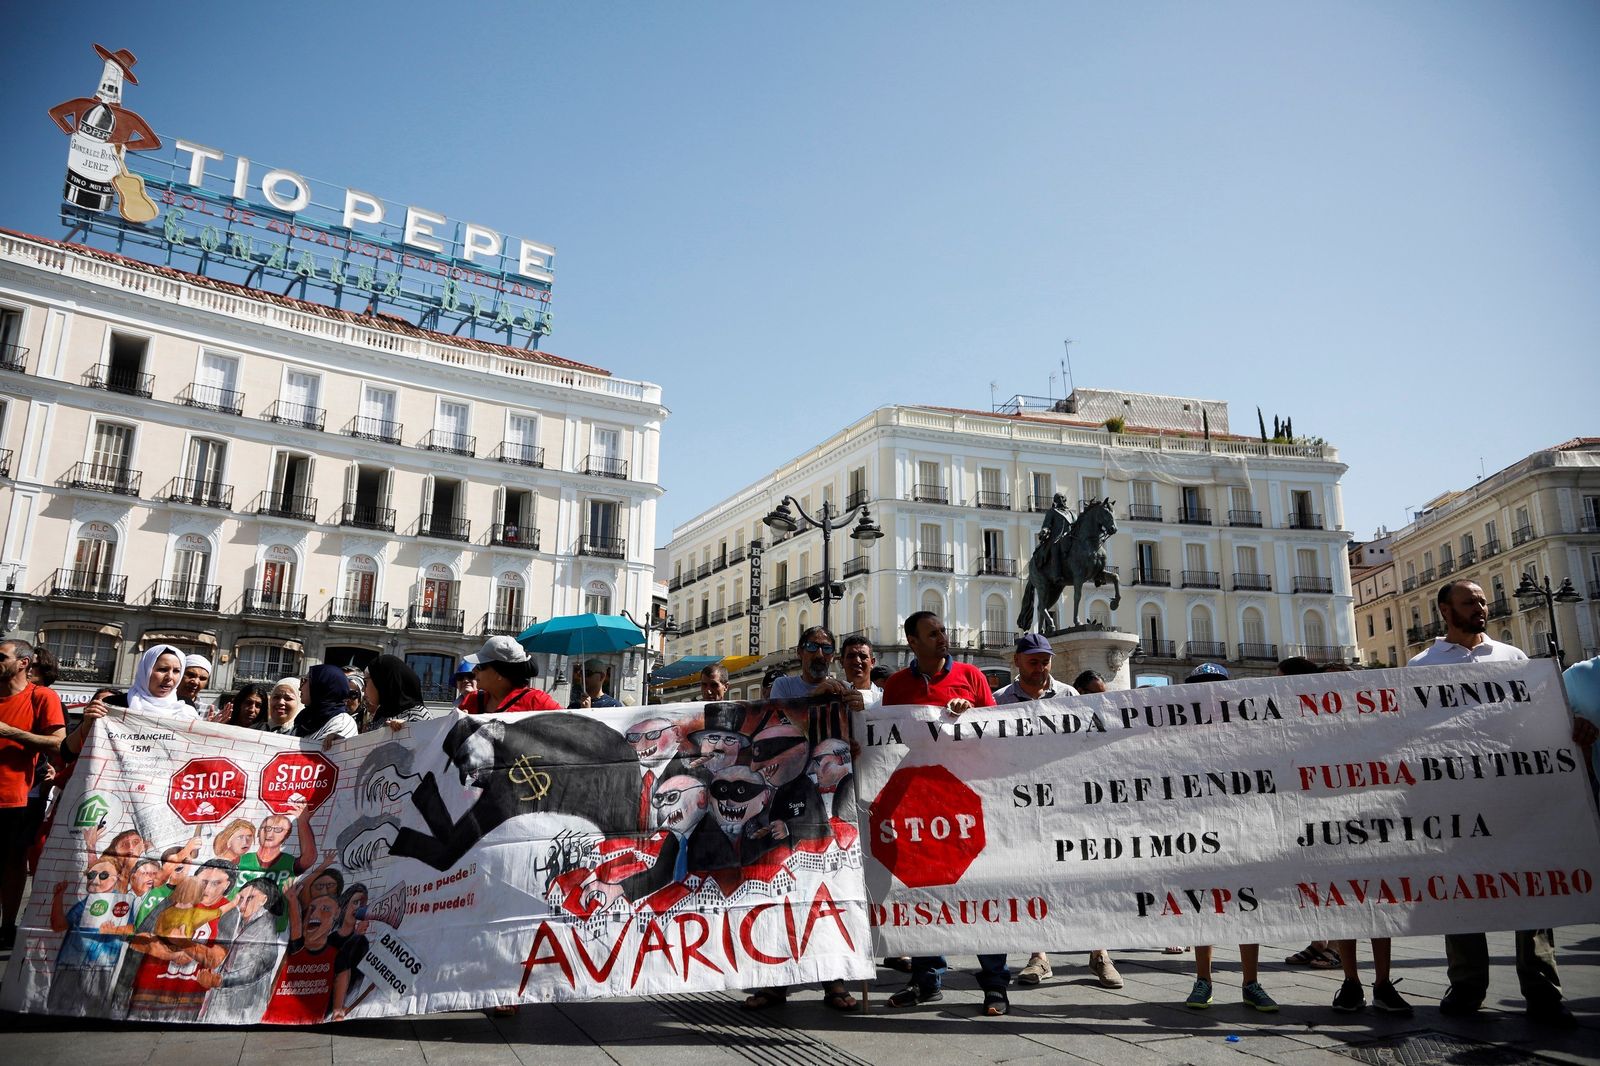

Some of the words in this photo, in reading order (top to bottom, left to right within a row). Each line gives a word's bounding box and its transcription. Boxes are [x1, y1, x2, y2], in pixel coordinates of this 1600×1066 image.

[70, 175, 87, 187] FINO
[82, 159, 109, 172] JEREZ
[175, 138, 311, 212] TIO
[342, 188, 556, 283] PEPE
[161, 190, 214, 215] SOL
[224, 207, 255, 226] DE
[266, 218, 393, 263] ANDALUCIA
[402, 252, 552, 303] EMBOTELLADO
[164, 207, 401, 298] GONZALEZ
[442, 277, 554, 336] BYASS
[752, 547, 761, 597] HOTEL
[866, 722, 908, 747] LA
[925, 711, 1107, 743] VIVIENDA
[1120, 697, 1284, 729] PUBLICA
[1296, 691, 1343, 718] NO
[1357, 688, 1400, 715] SE
[1413, 680, 1531, 710] VENDE
[107, 732, 176, 740] CARABANCHEL
[131, 745, 151, 753] 15M
[181, 771, 235, 790] STOP
[268, 779, 328, 791] DESAHUCIOS
[275, 763, 326, 782] STOP
[1013, 782, 1055, 808] SE
[1083, 769, 1277, 805] DEFIENDE
[1298, 760, 1417, 792] FUERA
[1420, 748, 1577, 781] BUITRES
[174, 789, 236, 800] DESAHUCIOS
[879, 813, 977, 844] STOP
[1055, 831, 1221, 862] PEDIMOS
[1296, 813, 1492, 847] JUSTICIA
[372, 886, 406, 923] 15M
[423, 882, 434, 893] se
[870, 896, 1049, 928] DESAUCIO
[1136, 887, 1259, 917] PAVPS
[1296, 867, 1593, 909] NAVALCARNERO
[419, 903, 430, 913] se
[380, 934, 422, 975] BANCOS
[518, 881, 856, 997] AVARICIA
[287, 963, 330, 973] BANCOS
[365, 952, 407, 994] USUREROS
